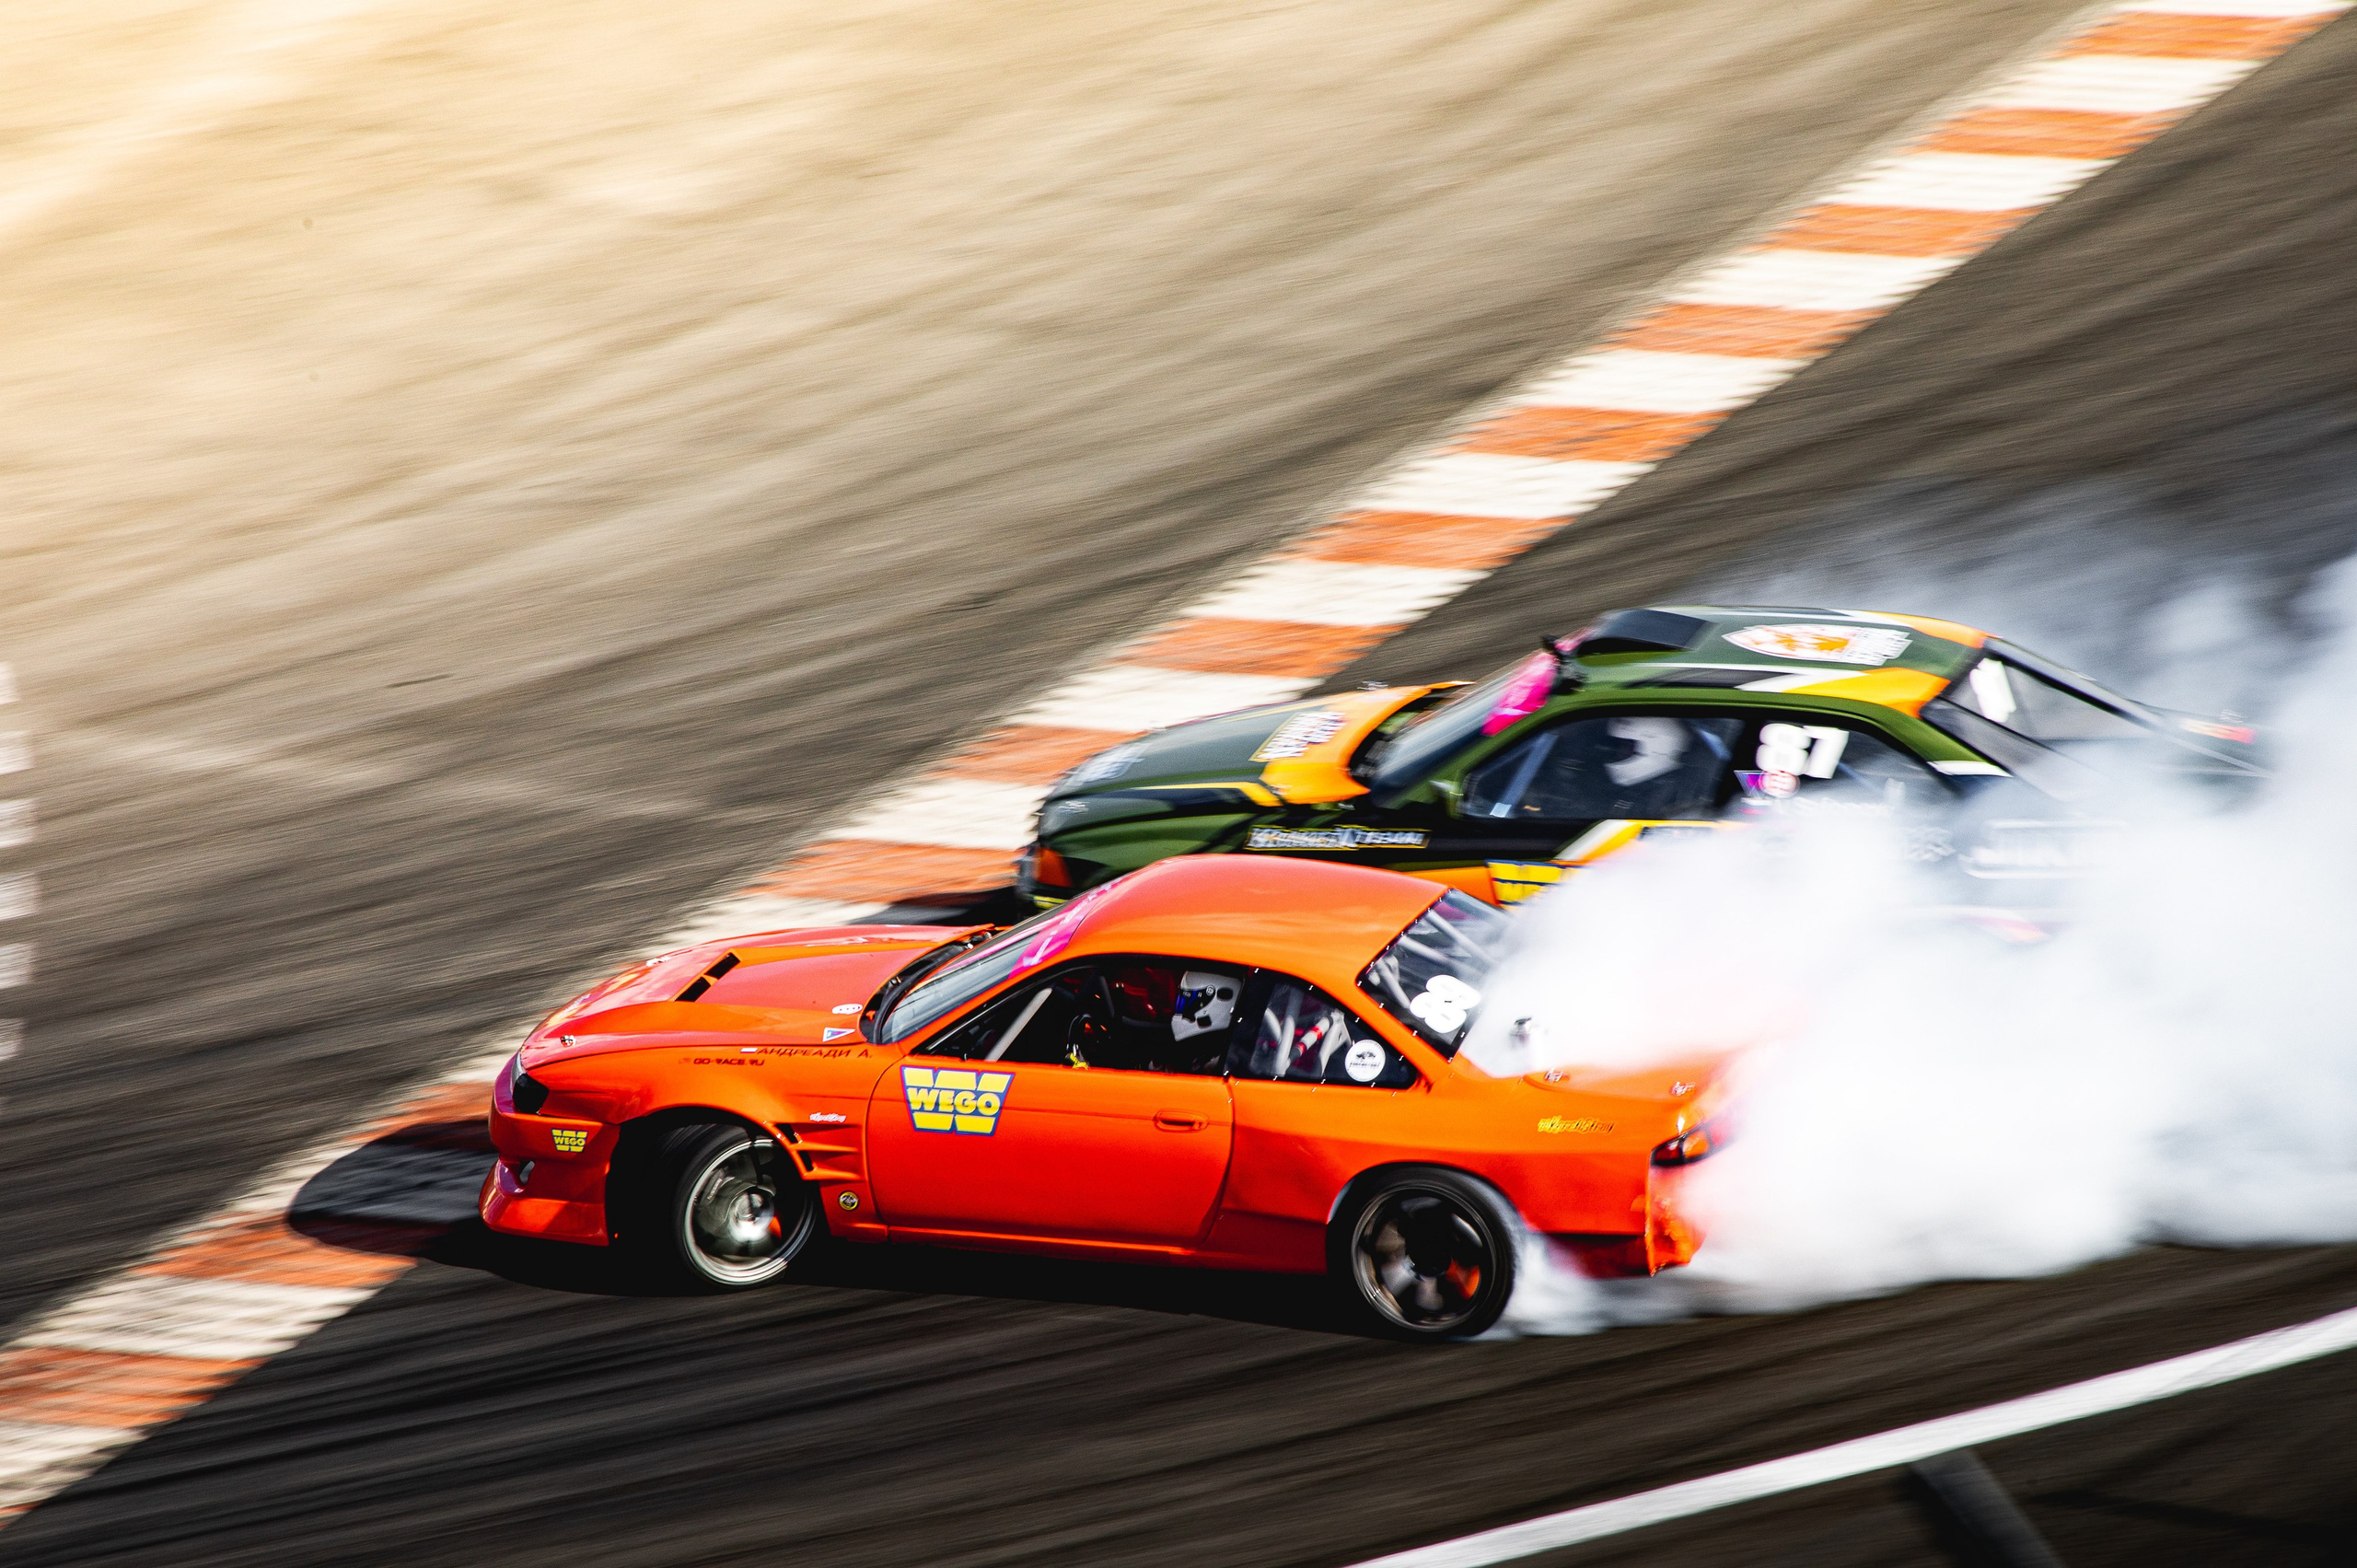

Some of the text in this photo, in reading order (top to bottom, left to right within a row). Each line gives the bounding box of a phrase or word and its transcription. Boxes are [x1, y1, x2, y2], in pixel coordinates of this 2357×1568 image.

[1755, 723, 1850, 780] 87
[756, 1047, 852, 1059] АНДРЕАДИ
[906, 1086, 1002, 1117] WEGO
[553, 1135, 586, 1147] WEGO
